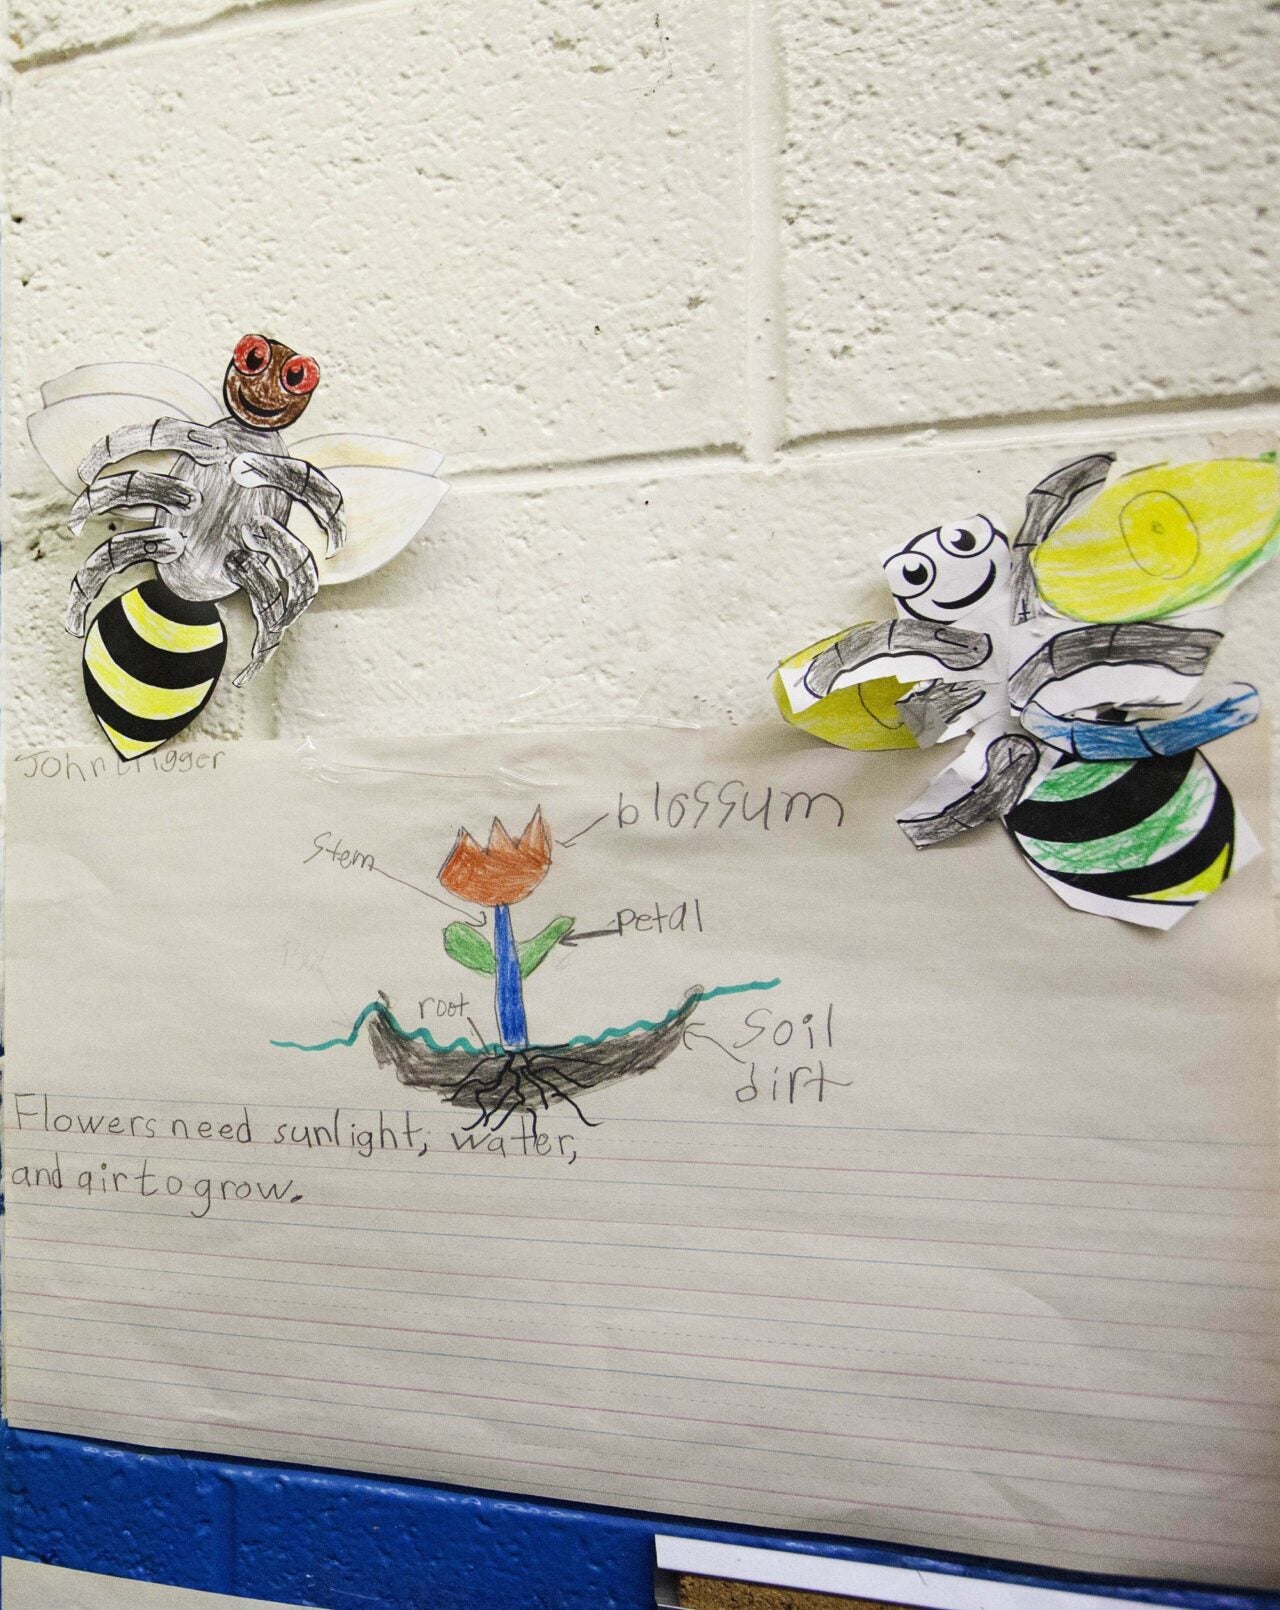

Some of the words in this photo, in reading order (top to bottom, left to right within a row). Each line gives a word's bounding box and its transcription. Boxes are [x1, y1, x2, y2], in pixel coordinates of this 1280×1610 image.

[14, 750, 107, 782] John
[618, 780, 845, 830] blossum
[616, 899, 703, 936] petal
[418, 992, 470, 1019] root
[735, 1060, 854, 1104] dirt
[14, 1093, 156, 1139] Flowers
[171, 1107, 252, 1144] need
[450, 1115, 577, 1165] water,
[11, 1152, 63, 1189] and
[190, 1178, 303, 1218] grow.
